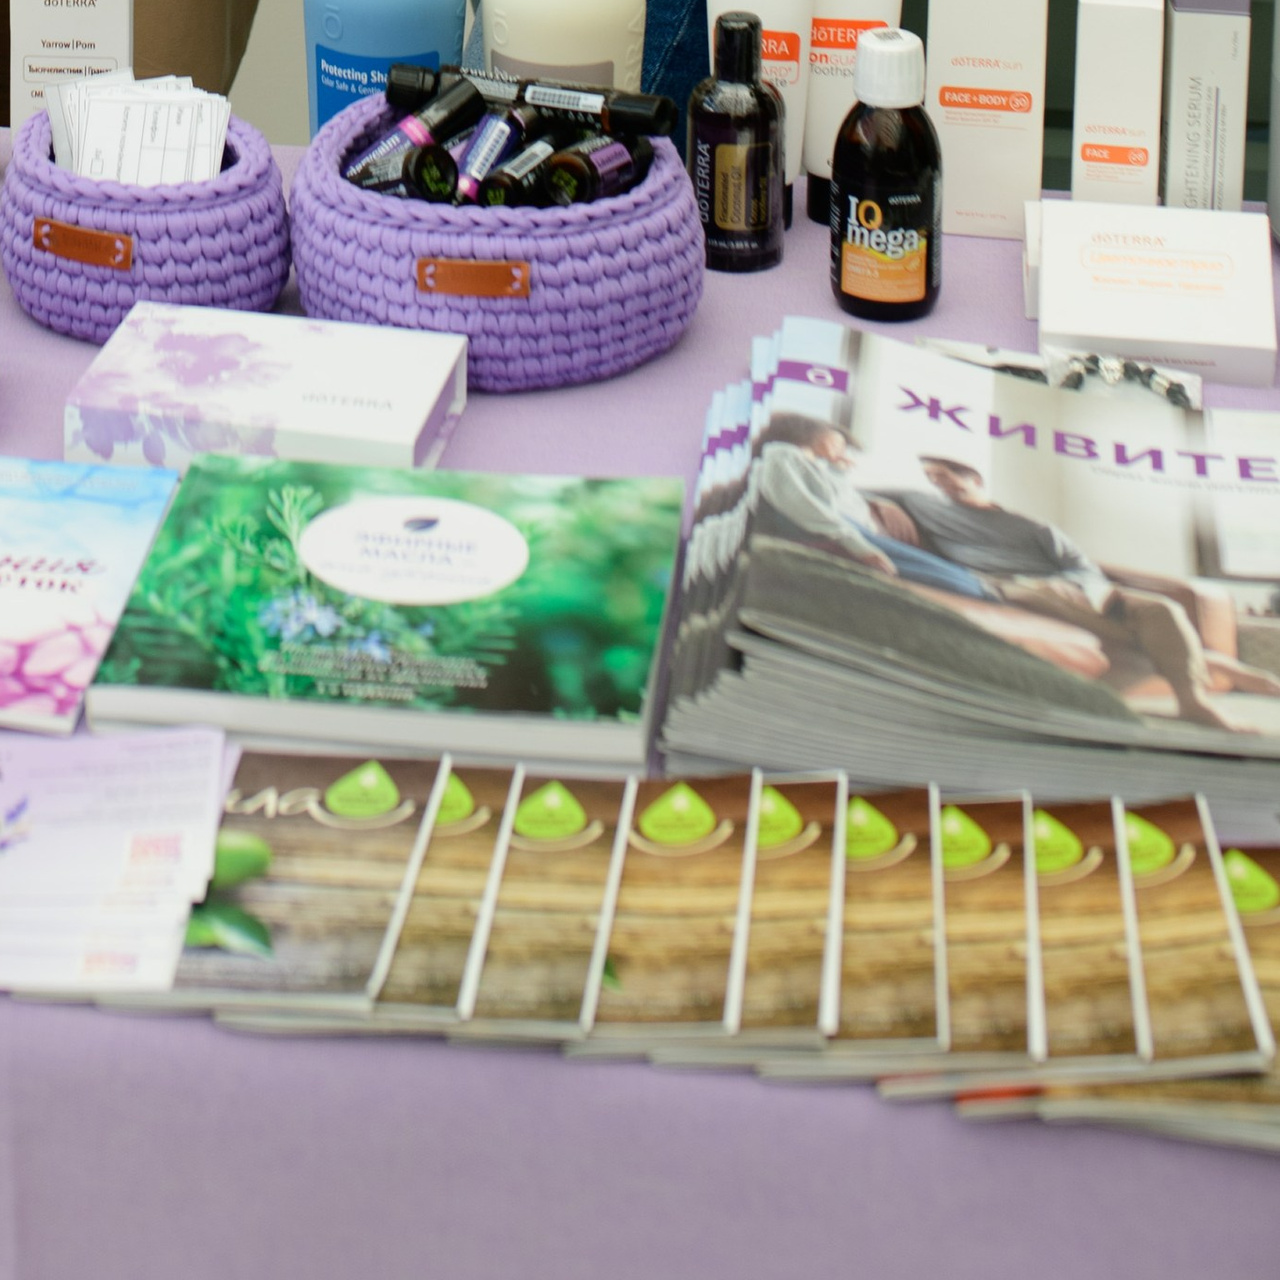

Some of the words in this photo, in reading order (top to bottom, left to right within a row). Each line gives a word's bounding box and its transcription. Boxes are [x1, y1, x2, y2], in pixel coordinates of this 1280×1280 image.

[812, 24, 859, 43] dōTER
[321, 58, 368, 85] Protecting
[945, 91, 971, 104] FACE
[979, 93, 1007, 106] BODY
[1187, 76, 1202, 126] SERUM
[847, 195, 883, 230] IQ
[847, 222, 919, 259] mega
[898, 386, 1280, 483] ЖИВИТЕ
